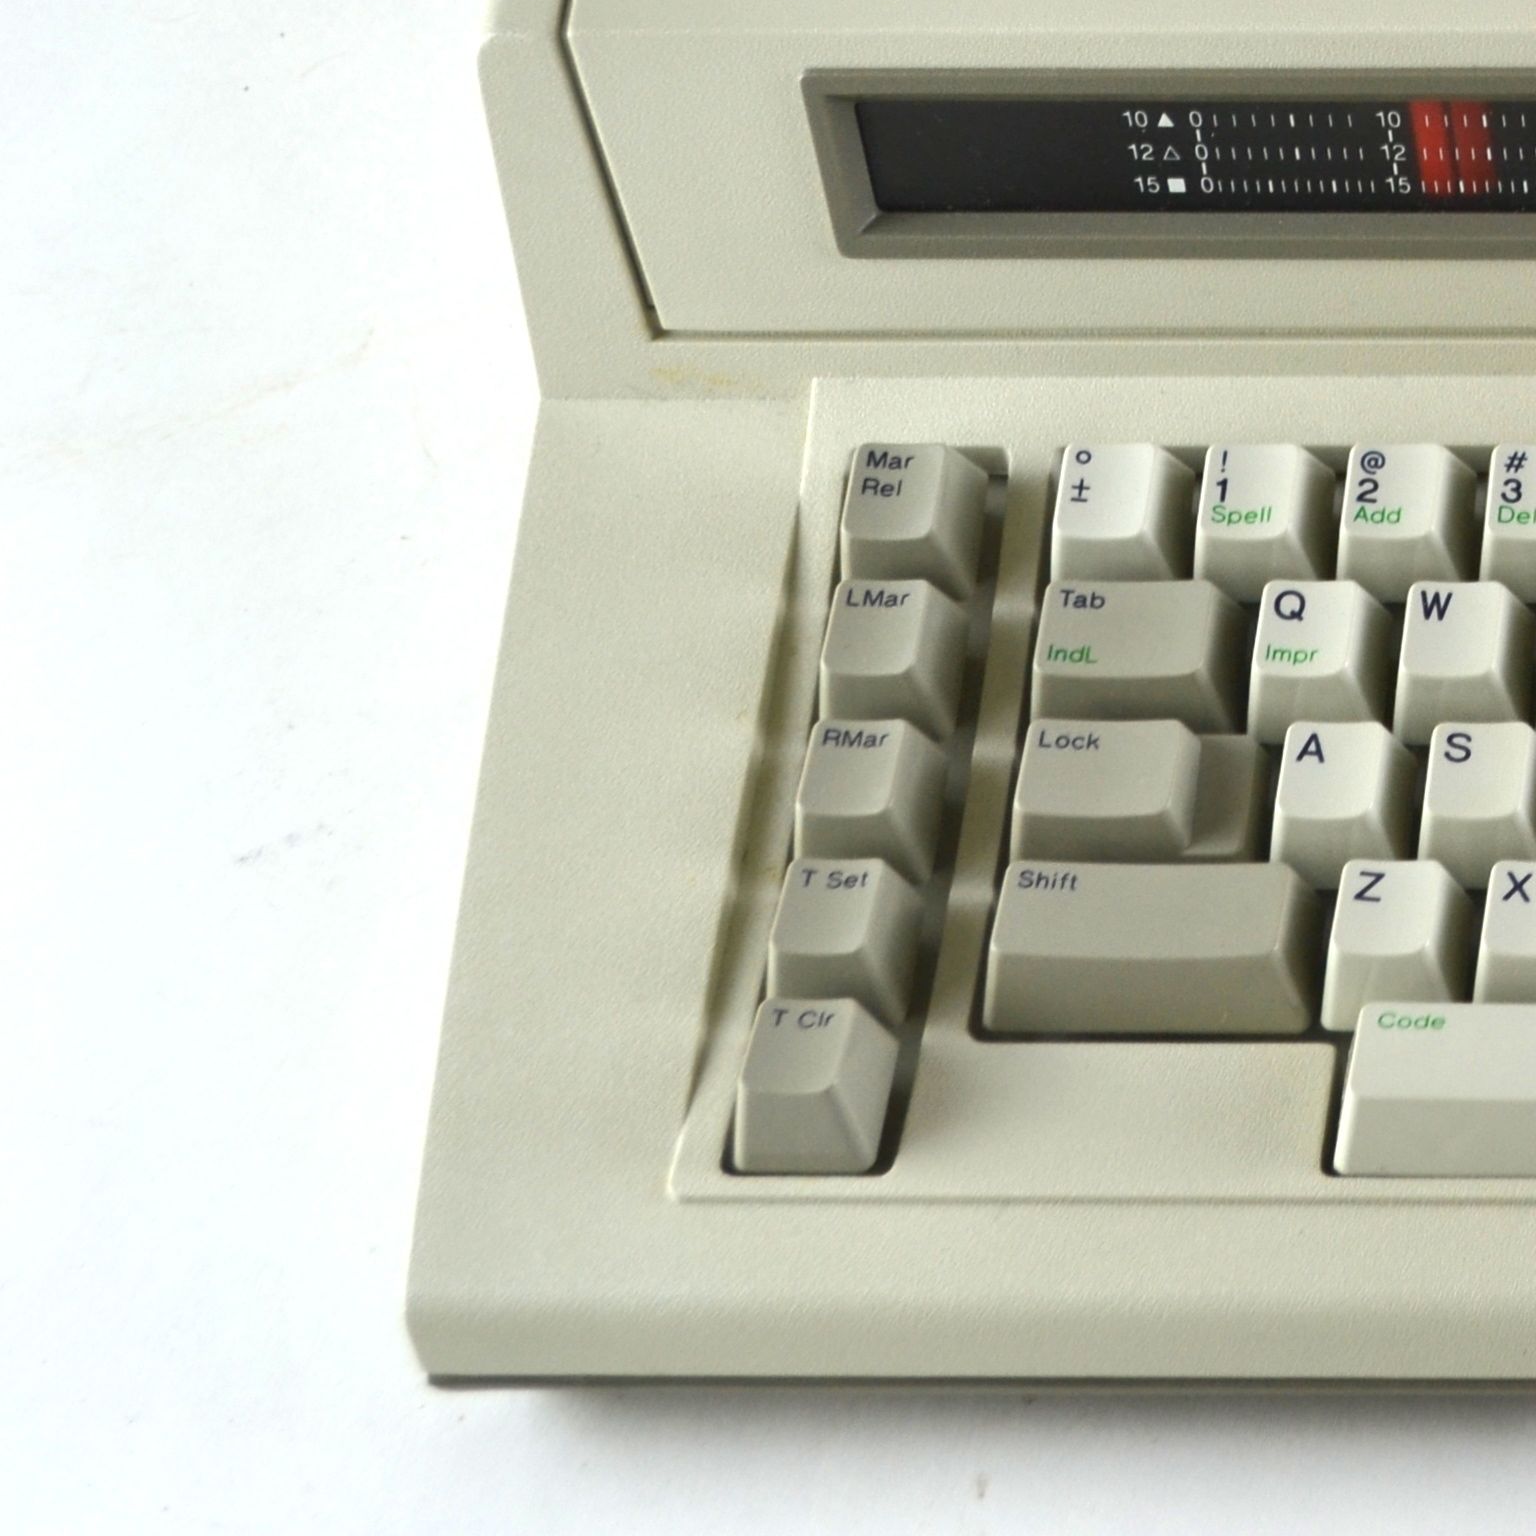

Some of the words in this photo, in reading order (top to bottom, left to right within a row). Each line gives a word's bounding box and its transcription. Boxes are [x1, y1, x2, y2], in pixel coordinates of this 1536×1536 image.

[1122, 110, 1148, 128] 10
[1188, 110, 1203, 132] 0
[1375, 111, 1401, 132] 10
[1128, 143, 1154, 161] 12
[1194, 143, 1209, 165] 0
[1380, 144, 1406, 161] 12
[1134, 176, 1160, 194] 15
[1200, 176, 1214, 194] 0
[1385, 176, 1411, 194] 15
[865, 449, 914, 470] Mar
[1359, 450, 1386, 476] @
[1504, 451, 1528, 474] #
[861, 476, 903, 498] Rel
[1216, 477, 1228, 503] 1
[1355, 477, 1379, 504] 2
[1500, 478, 1523, 504] 3
[1210, 503, 1272, 527] Spell
[1353, 504, 1402, 524] Add
[845, 587, 910, 608] LMar
[1060, 589, 1106, 610] Tab
[1273, 589, 1306, 622] Q
[1420, 589, 1453, 621] W
[1046, 644, 1097, 664] IndL
[1265, 643, 1318, 666] Impr
[821, 727, 888, 749] RMar
[1038, 729, 1100, 751] Lock
[1296, 732, 1325, 764] A
[1443, 732, 1472, 764] S
[801, 868, 817, 888] T
[825, 870, 868, 890] Set
[1017, 869, 1078, 891] Shift
[1353, 870, 1386, 903] Z
[1502, 871, 1533, 903] X
[773, 1008, 789, 1027] T
[796, 1009, 835, 1030] Clr
[1377, 1012, 1446, 1030] Code
